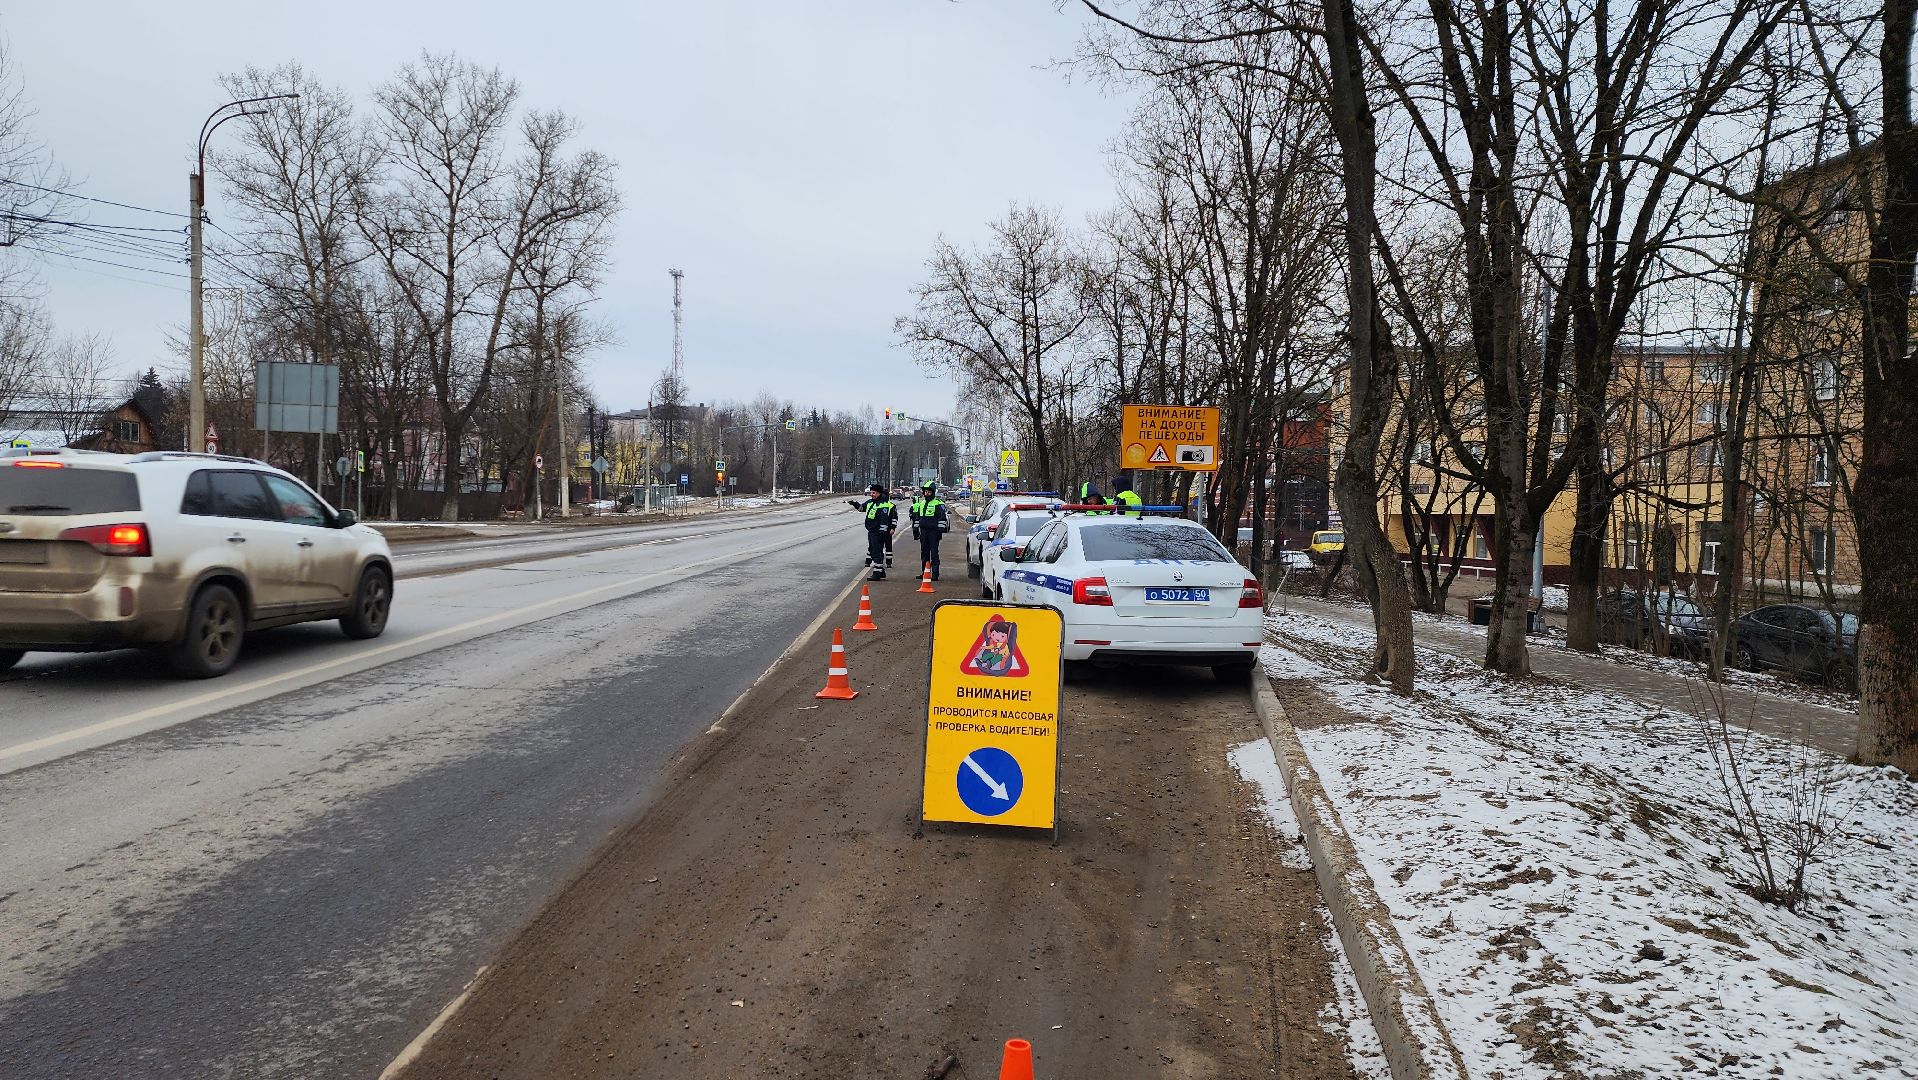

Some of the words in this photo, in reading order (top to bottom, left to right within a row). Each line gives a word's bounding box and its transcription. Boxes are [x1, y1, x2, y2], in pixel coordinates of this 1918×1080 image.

[1138, 408, 1206, 419] ВНИМАНИЕ!
[1140, 420, 1156, 428] НА
[1160, 421, 1206, 430] ДОРОГЕ
[1139, 431, 1204, 442] ПЕШЕХОДЫ
[1161, 589, 1190, 600] 5072
[1195, 589, 1206, 598] 50
[956, 686, 1032, 701] ВНИМАНИЕ!
[933, 706, 998, 718] ПРОВОДИТСЯ
[1000, 710, 1054, 721] МАССОВАЯ
[935, 721, 986, 733] ПРОВЕРКА
[989, 724, 1050, 736] ВОДИТЕЛЕЙ!
